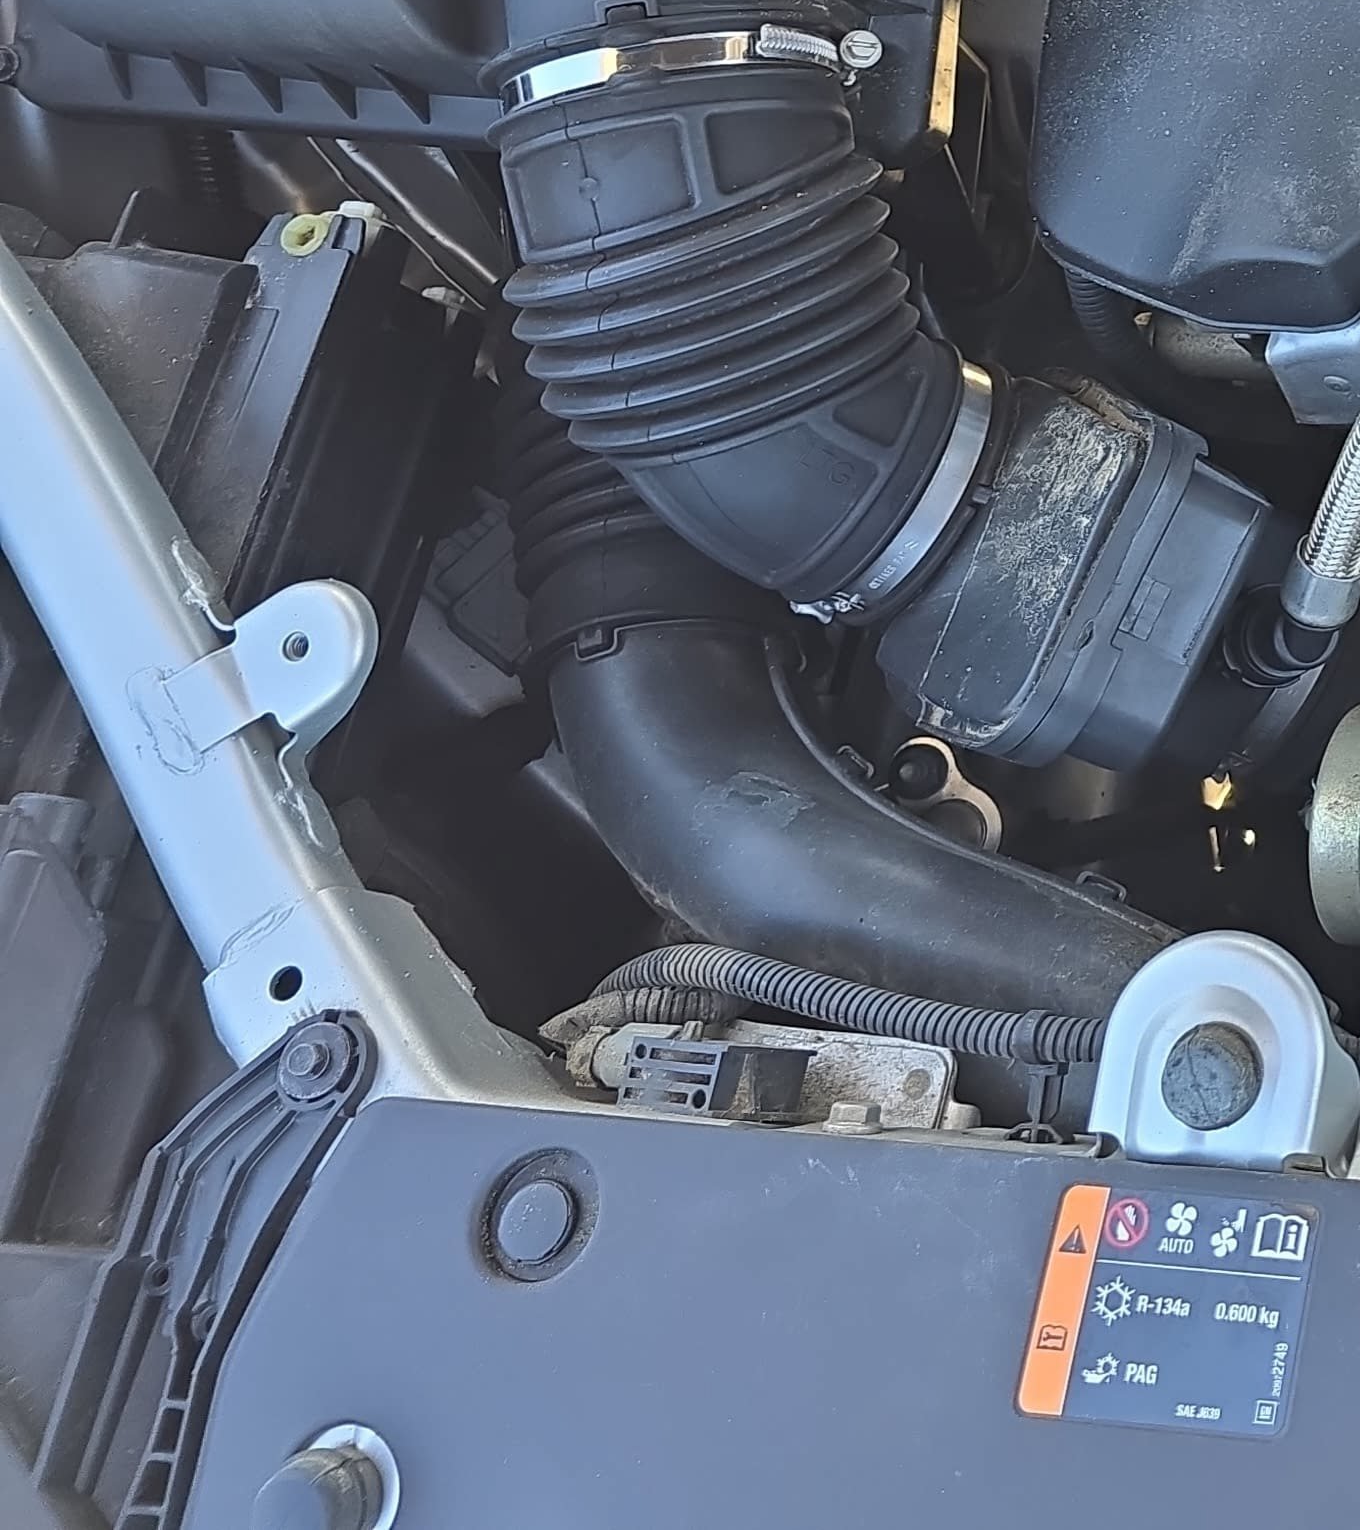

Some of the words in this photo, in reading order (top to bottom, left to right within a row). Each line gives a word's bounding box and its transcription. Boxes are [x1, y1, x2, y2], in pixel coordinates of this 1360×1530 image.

[1158, 1237, 1194, 1254] AUTO
[1136, 1294, 1191, 1317] R-134a
[1215, 1302, 1257, 1323] 0.600
[1258, 1306, 1280, 1329] kg
[1124, 1363, 1158, 1384] PAG
[1175, 1404, 1196, 1419] SAE
